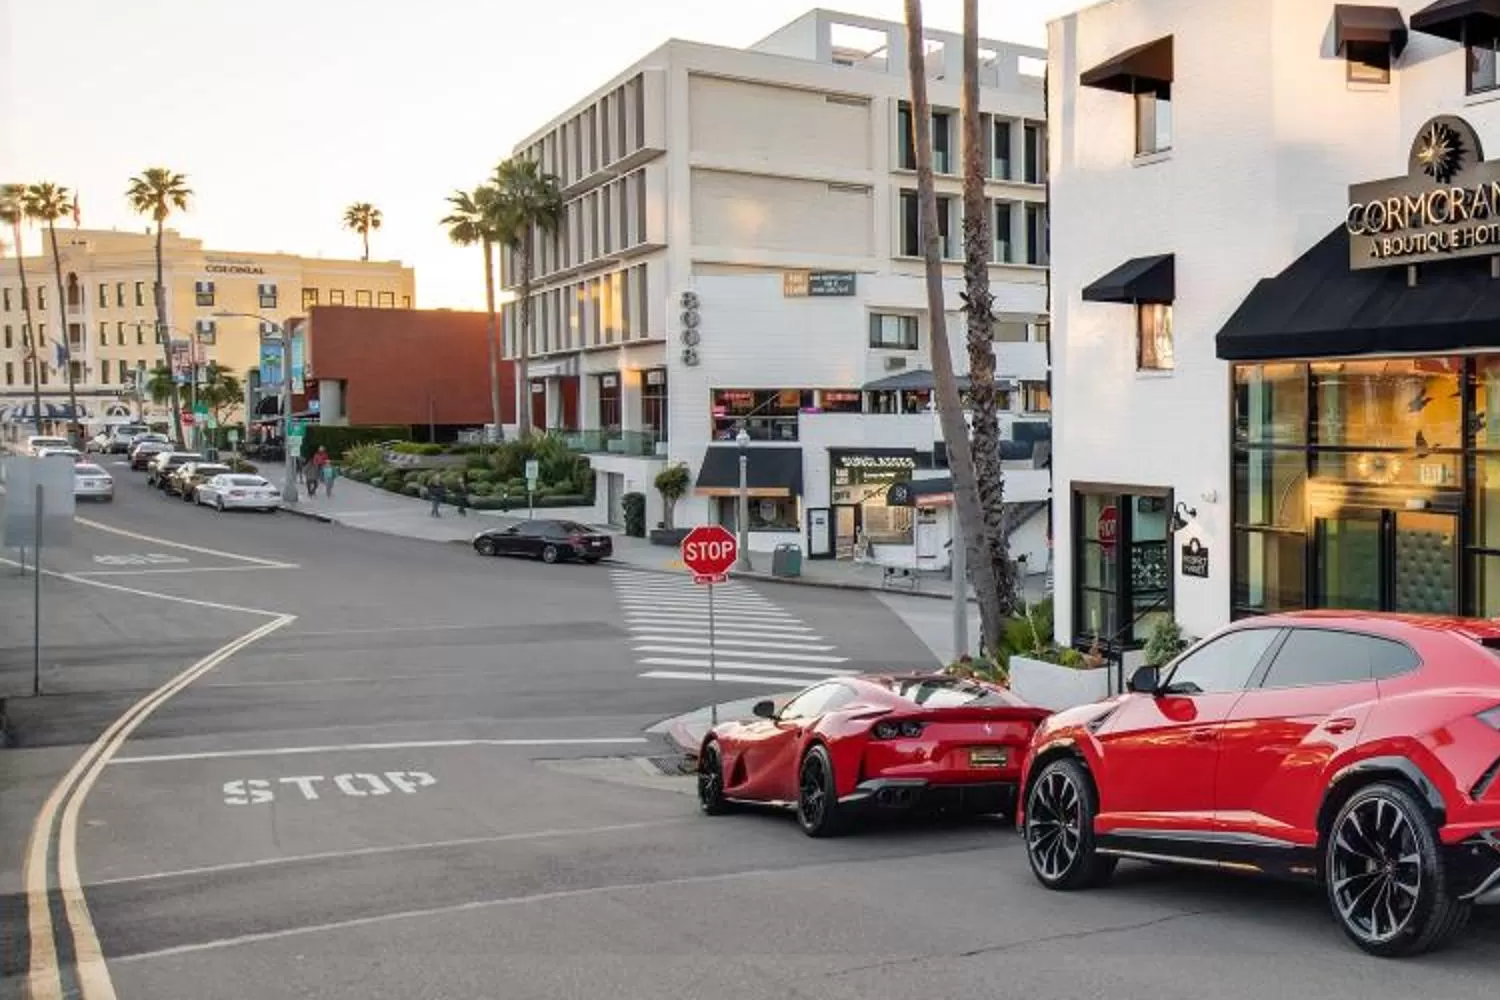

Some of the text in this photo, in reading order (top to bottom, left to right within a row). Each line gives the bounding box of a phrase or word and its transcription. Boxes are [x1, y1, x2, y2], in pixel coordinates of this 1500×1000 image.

[1369, 236, 1380, 258] A
[1383, 229, 1459, 257] BOUTIQUE
[686, 541, 734, 561] STOP
[223, 771, 437, 805] STOP
